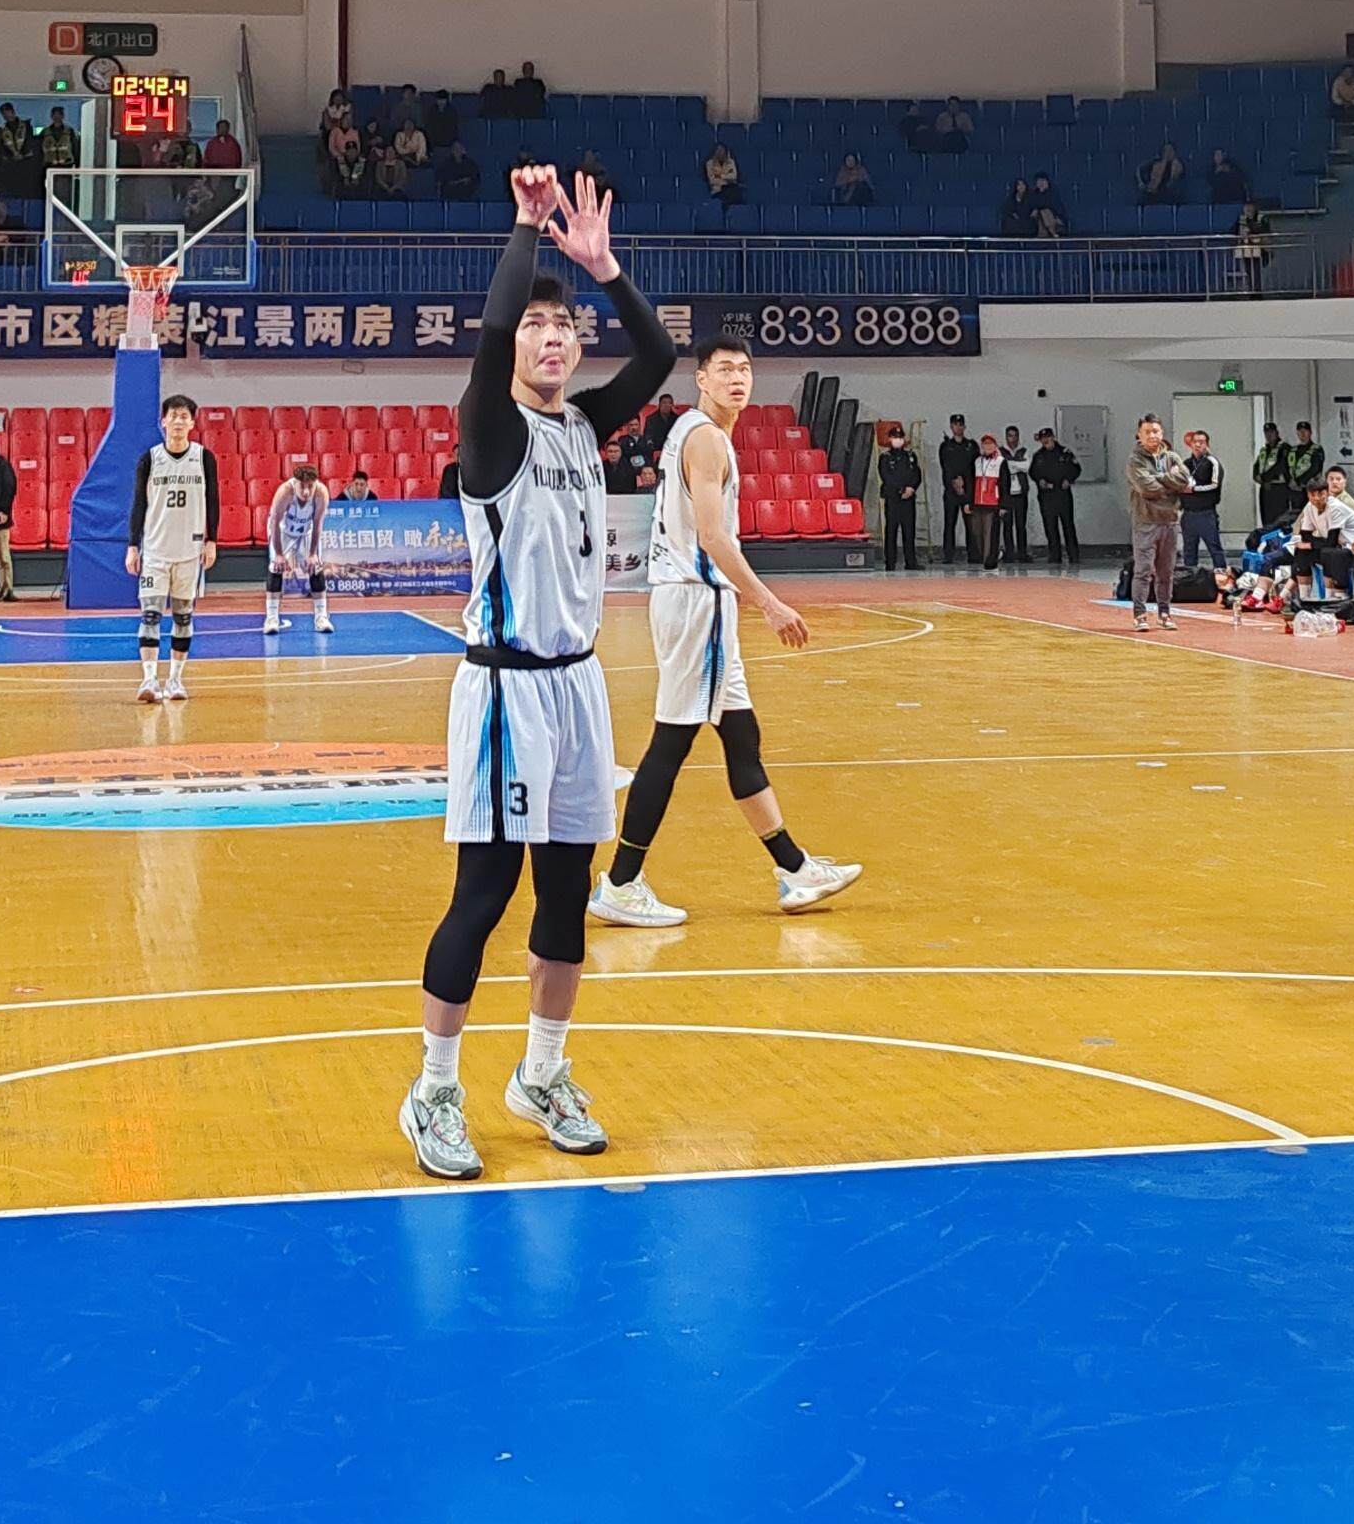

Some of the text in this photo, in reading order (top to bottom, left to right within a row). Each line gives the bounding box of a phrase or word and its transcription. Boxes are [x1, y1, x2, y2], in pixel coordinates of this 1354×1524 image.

[56, 26, 78, 51] D
[113, 77, 187, 96] 02:42.4
[125, 97, 174, 132] 24
[722, 306, 963, 346] 0762 833 8888
[167, 490, 186, 508] 28
[140, 577, 154, 589] 28
[338, 580, 365, 591] 8888
[509, 781, 528, 816] 3
